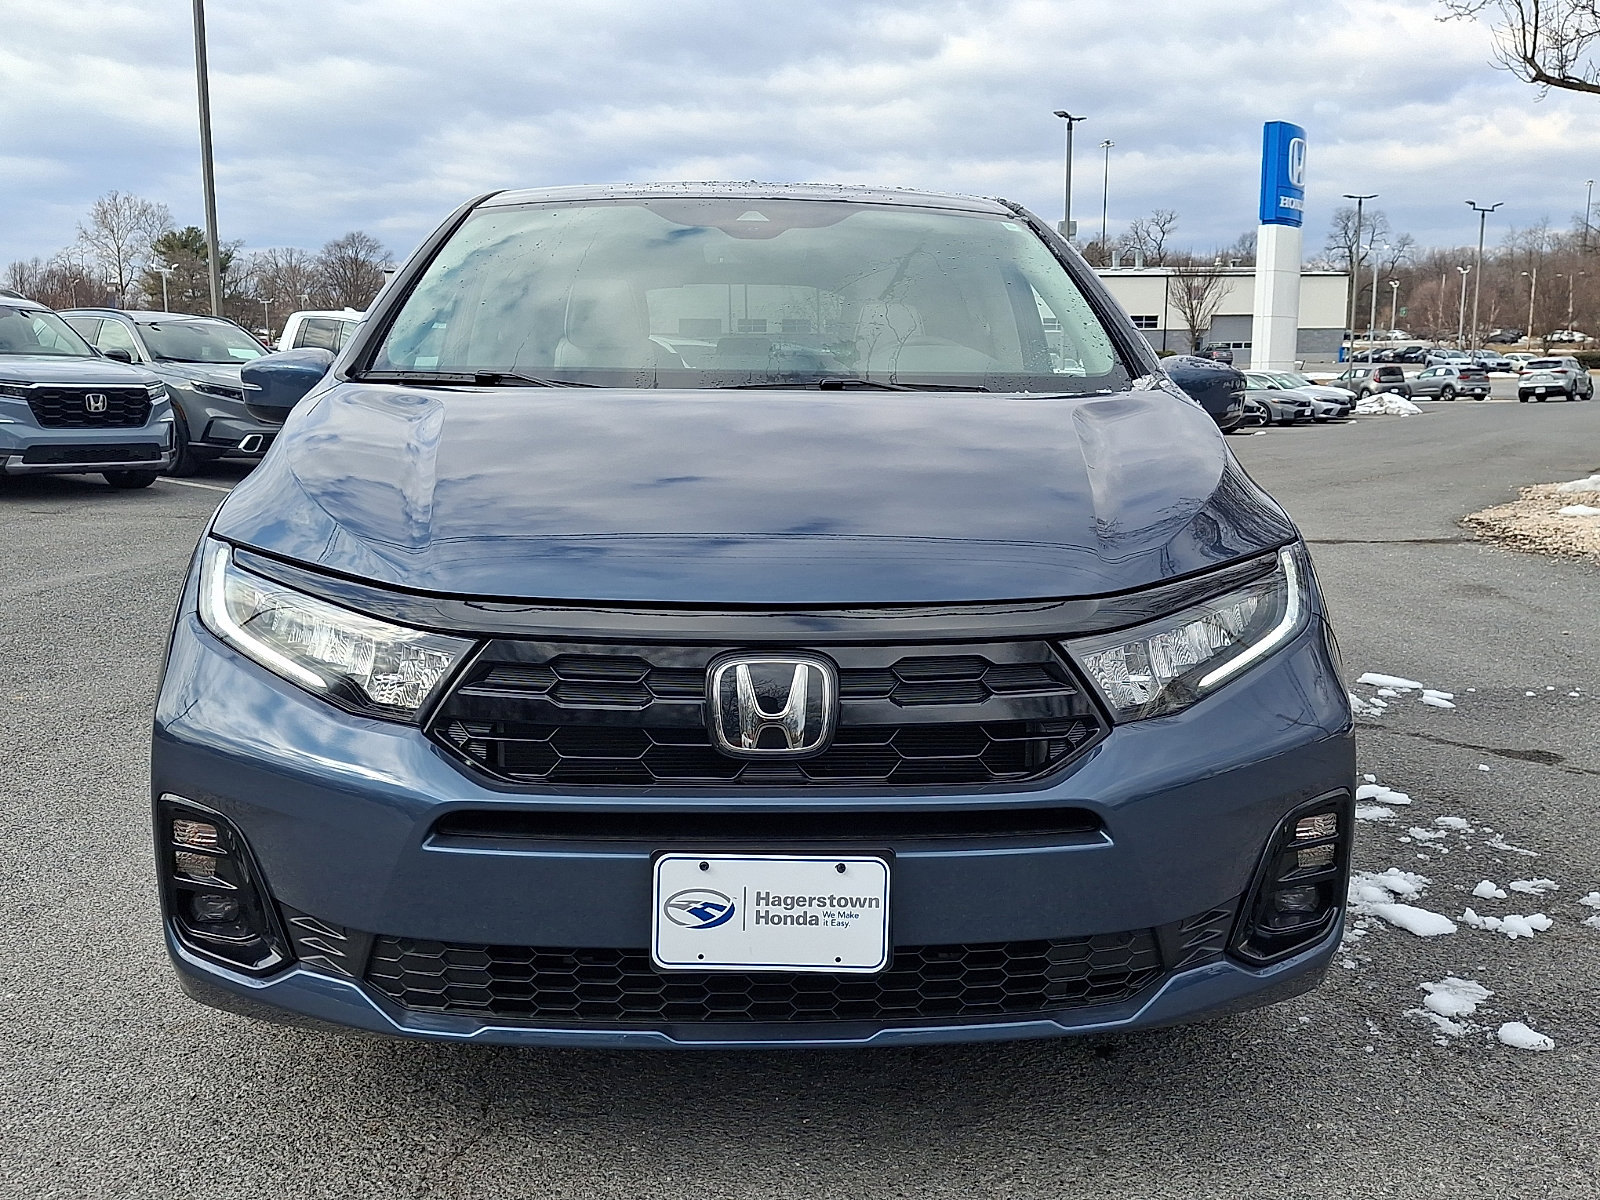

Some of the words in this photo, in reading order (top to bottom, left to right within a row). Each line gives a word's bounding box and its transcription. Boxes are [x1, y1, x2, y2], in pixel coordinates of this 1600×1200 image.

[755, 891, 880, 911] Hagerstown
[755, 909, 820, 926] Honda
[822, 910, 836, 919] We
[837, 911, 860, 919] Make
[823, 919, 829, 927] it
